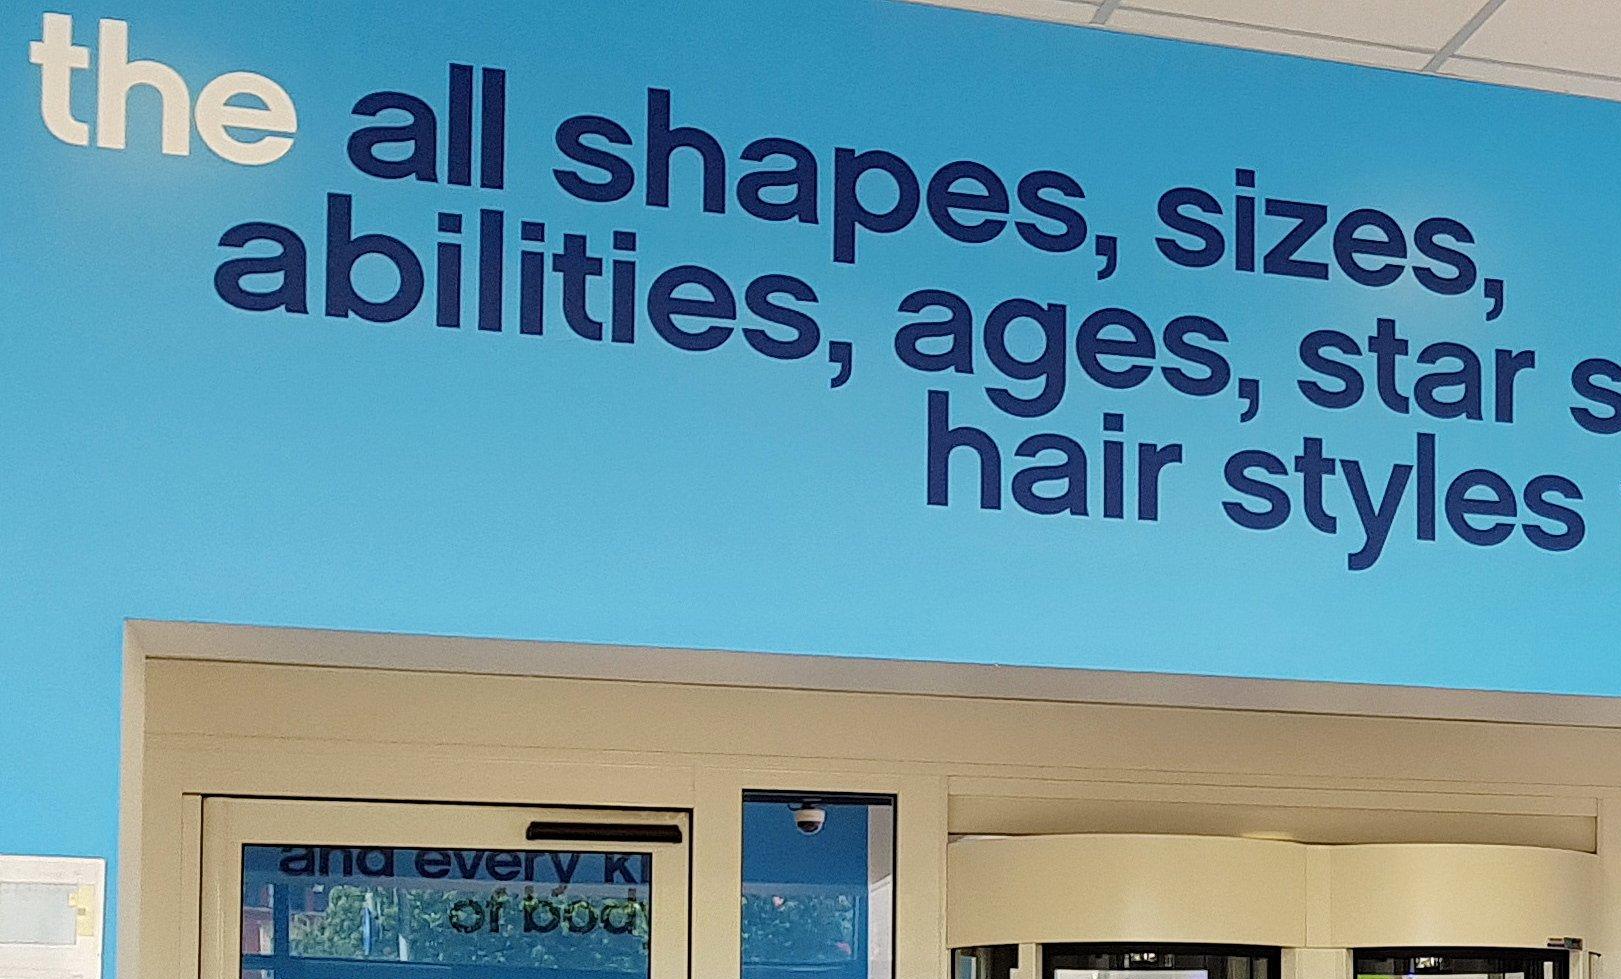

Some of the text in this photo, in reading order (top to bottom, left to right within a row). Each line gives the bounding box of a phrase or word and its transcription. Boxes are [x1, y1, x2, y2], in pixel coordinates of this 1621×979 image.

[28, 12, 1505, 322] the all shapes, sizes,
[213, 193, 854, 389] abilities,
[894, 289, 1261, 424] ages,
[1297, 318, 1536, 424] star
[926, 390, 1183, 522] hair
[1222, 432, 1587, 572] styles
[522, 885, 647, 935] bod
